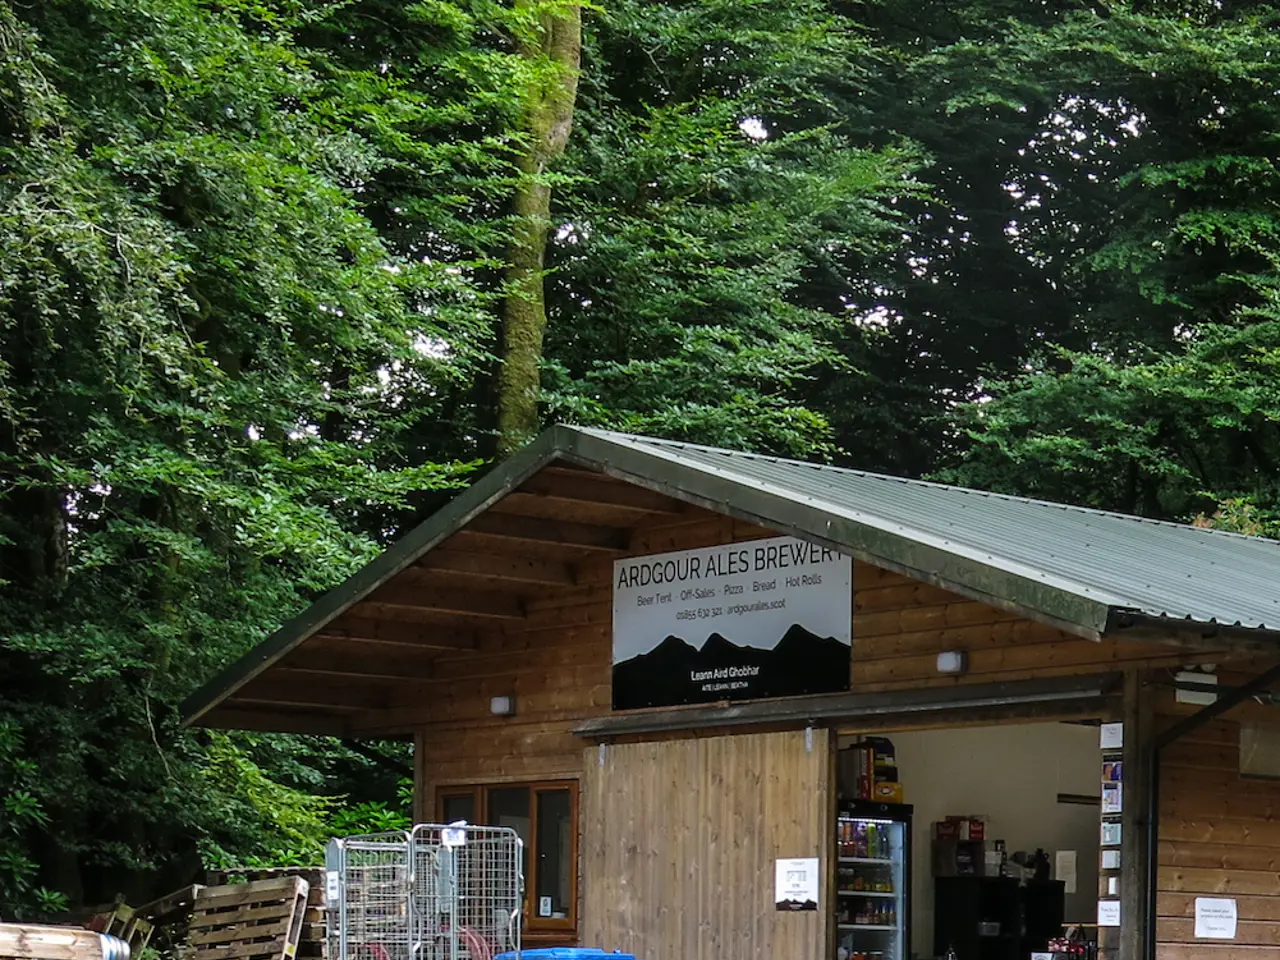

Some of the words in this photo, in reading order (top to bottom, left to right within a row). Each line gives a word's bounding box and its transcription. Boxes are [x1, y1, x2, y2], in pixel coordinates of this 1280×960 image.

[617, 557, 701, 590] ARDGOUR
[705, 550, 750, 578] ALES
[637, 596, 654, 607] Beer
[655, 592, 673, 604] Tent
[680, 587, 716, 601] Off-Sales
[724, 584, 744, 596] Pizza
[752, 579, 777, 592] Bread
[785, 576, 801, 588] Hot
[801, 573, 822, 586] Rolls
[691, 670, 713, 681] Leann
